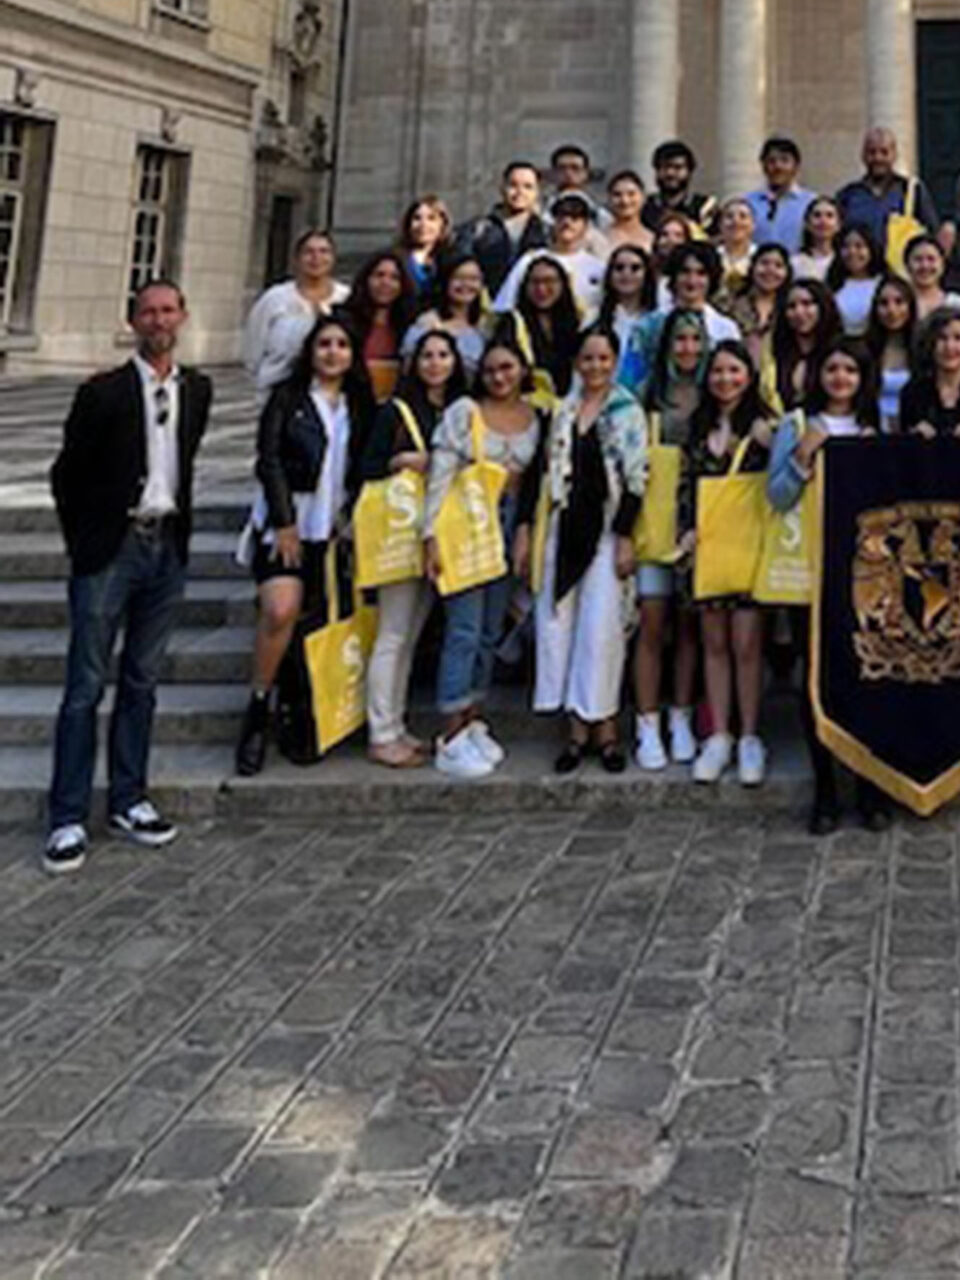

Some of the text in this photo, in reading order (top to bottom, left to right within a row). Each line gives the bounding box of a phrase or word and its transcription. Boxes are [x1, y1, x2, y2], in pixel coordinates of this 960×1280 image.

[386, 477, 417, 529] S
[465, 480, 489, 531] S
[780, 511, 802, 552] S
[343, 633, 364, 683] S
